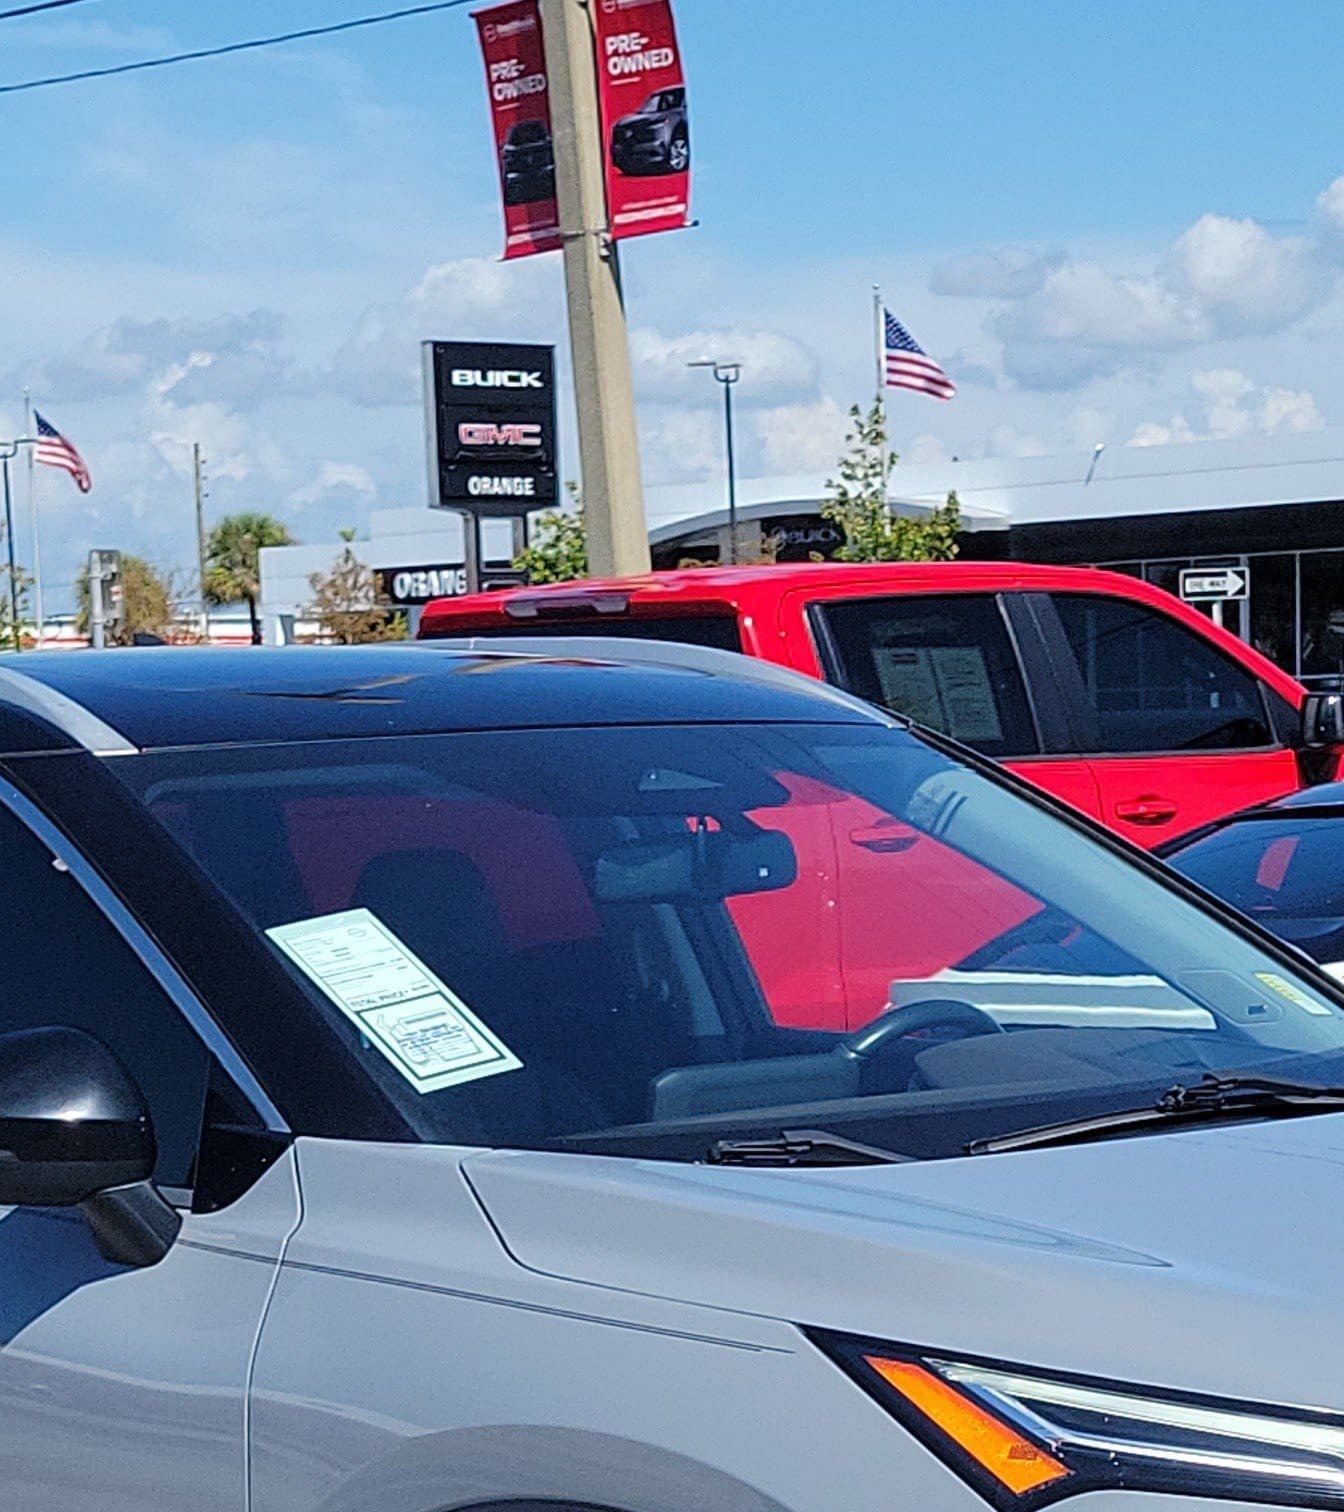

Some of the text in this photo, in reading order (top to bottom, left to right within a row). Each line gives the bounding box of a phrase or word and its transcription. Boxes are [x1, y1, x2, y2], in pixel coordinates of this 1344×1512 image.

[605, 32, 649, 56] PRE-
[490, 59, 525, 82] PRE-
[608, 48, 674, 75] OWNED
[493, 73, 546, 100] OWNED
[452, 370, 544, 388] BUICK
[458, 424, 542, 446] GMC
[468, 476, 535, 495] ORANGE
[393, 569, 467, 599] ORANG
